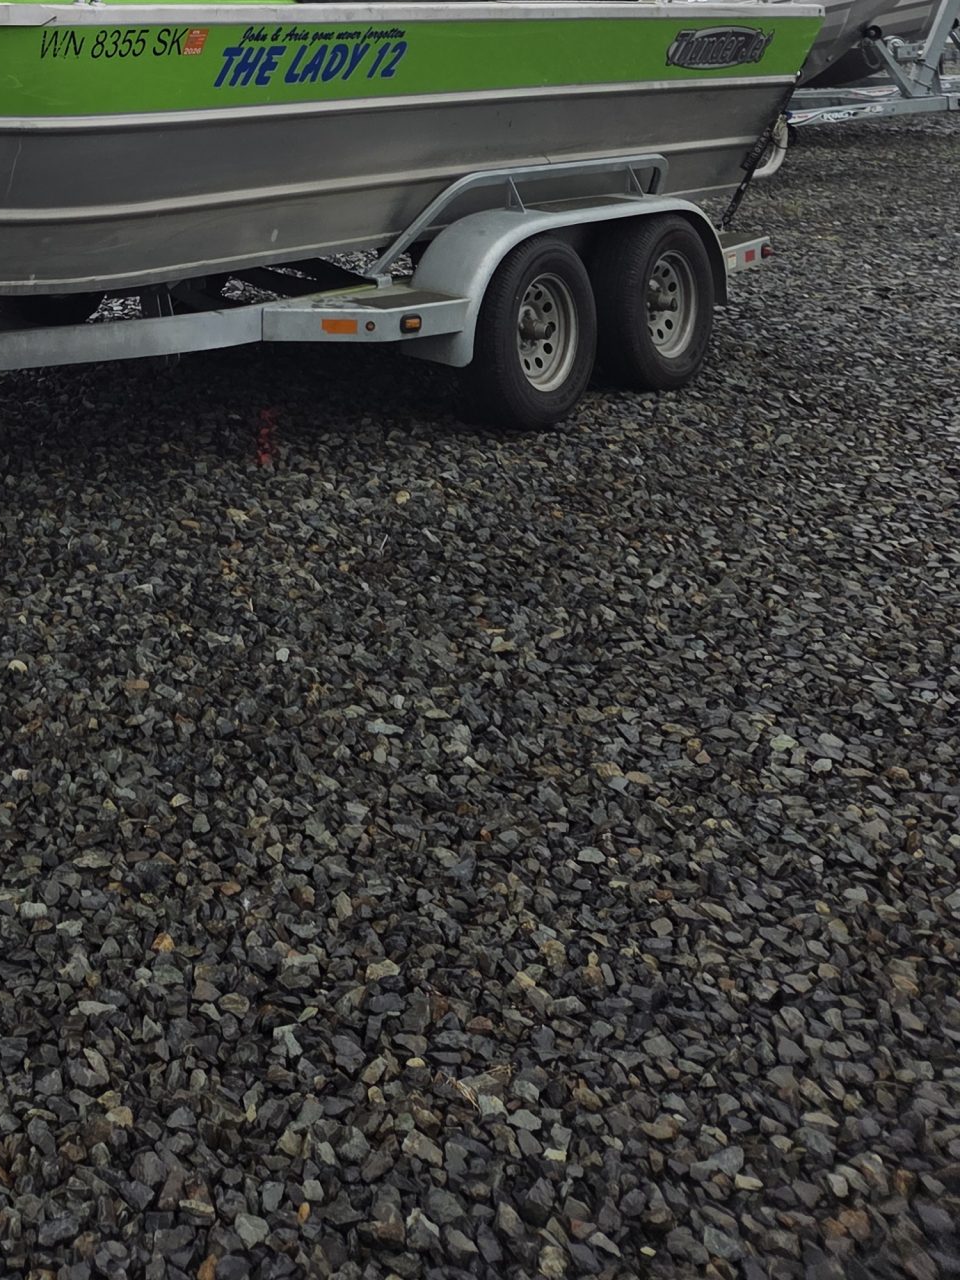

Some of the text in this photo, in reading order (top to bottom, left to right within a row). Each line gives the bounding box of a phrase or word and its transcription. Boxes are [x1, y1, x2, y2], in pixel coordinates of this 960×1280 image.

[40, 27, 189, 59] WN 8355 SK
[239, 26, 268, 47] John
[270, 26, 283, 43] &
[360, 26, 406, 44] forgotten
[213, 41, 408, 87] THE LADY 12
